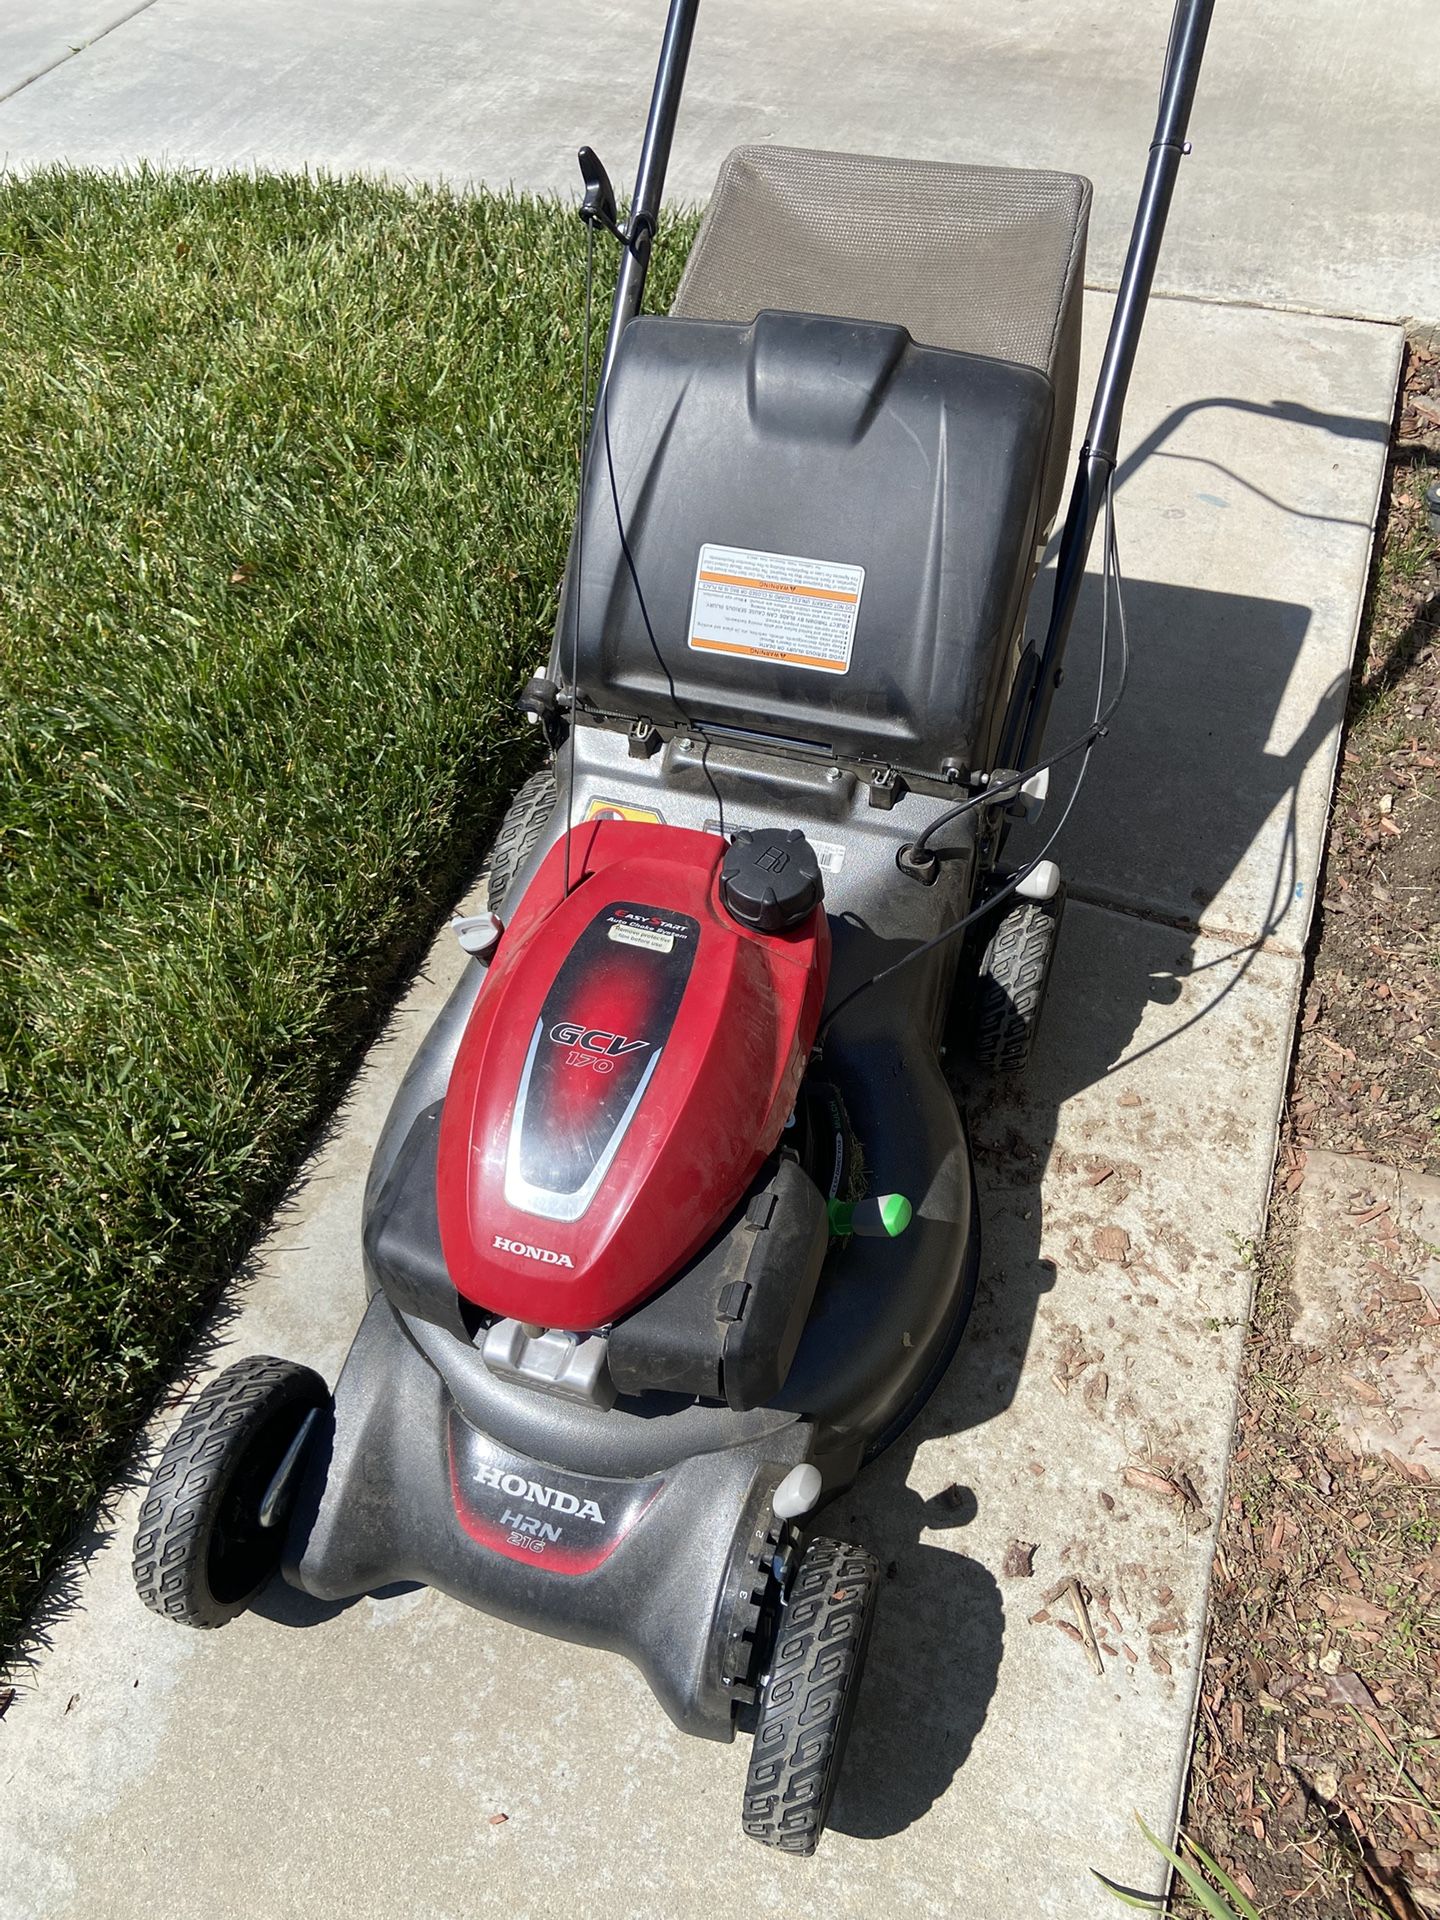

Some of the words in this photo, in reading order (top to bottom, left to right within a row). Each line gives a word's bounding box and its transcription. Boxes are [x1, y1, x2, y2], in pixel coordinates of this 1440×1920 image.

[759, 582, 788, 590] WARNING
[750, 648, 778, 657] WARNING
[606, 916, 628, 925] Auto
[629, 922, 655, 930] Choke
[656, 928, 688, 940] System
[550, 1022, 651, 1056] GCV
[566, 1051, 614, 1074] 170
[830, 1101, 842, 1128] MULCH
[492, 1236, 574, 1268] HONDA
[472, 1462, 606, 1524] HONDA
[500, 1509, 562, 1542] HRN
[756, 1530, 764, 1538] 2
[506, 1531, 546, 1554] 216
[740, 1590, 748, 1600] 3
[722, 1676, 732, 1686] 4
